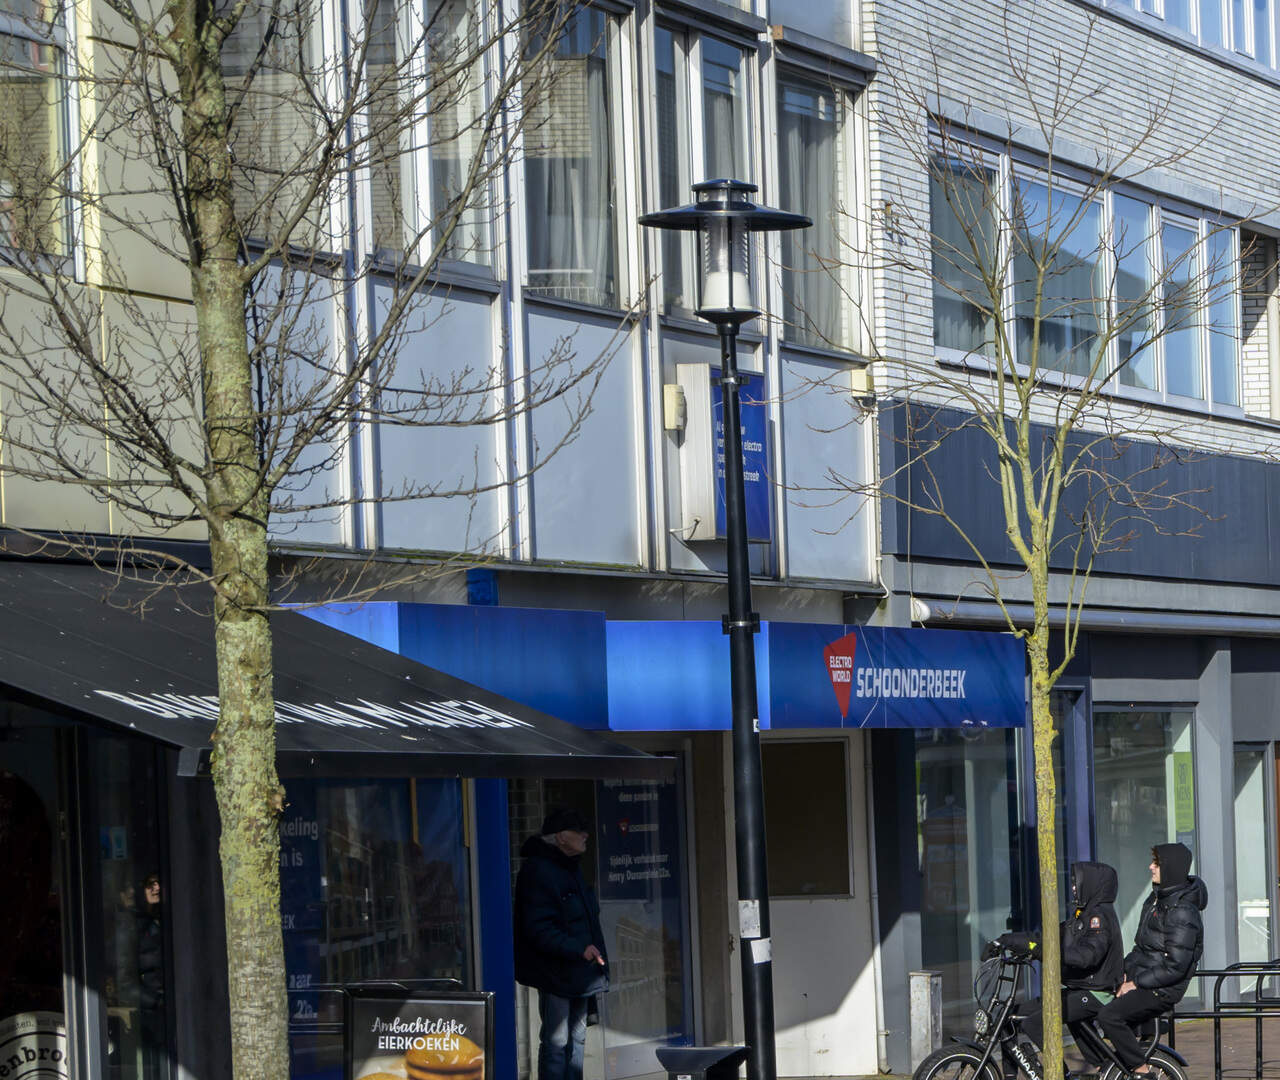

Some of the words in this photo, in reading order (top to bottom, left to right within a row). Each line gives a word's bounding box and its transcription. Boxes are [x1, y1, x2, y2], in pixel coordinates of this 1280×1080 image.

[829, 655, 852, 668] ELECTRO
[832, 670, 851, 682] WORLD
[856, 667, 966, 699] SCHOONDERBEEK
[370, 1016, 467, 1039] Ambachtelijke
[378, 1035, 460, 1051] EIERKOEKEN
